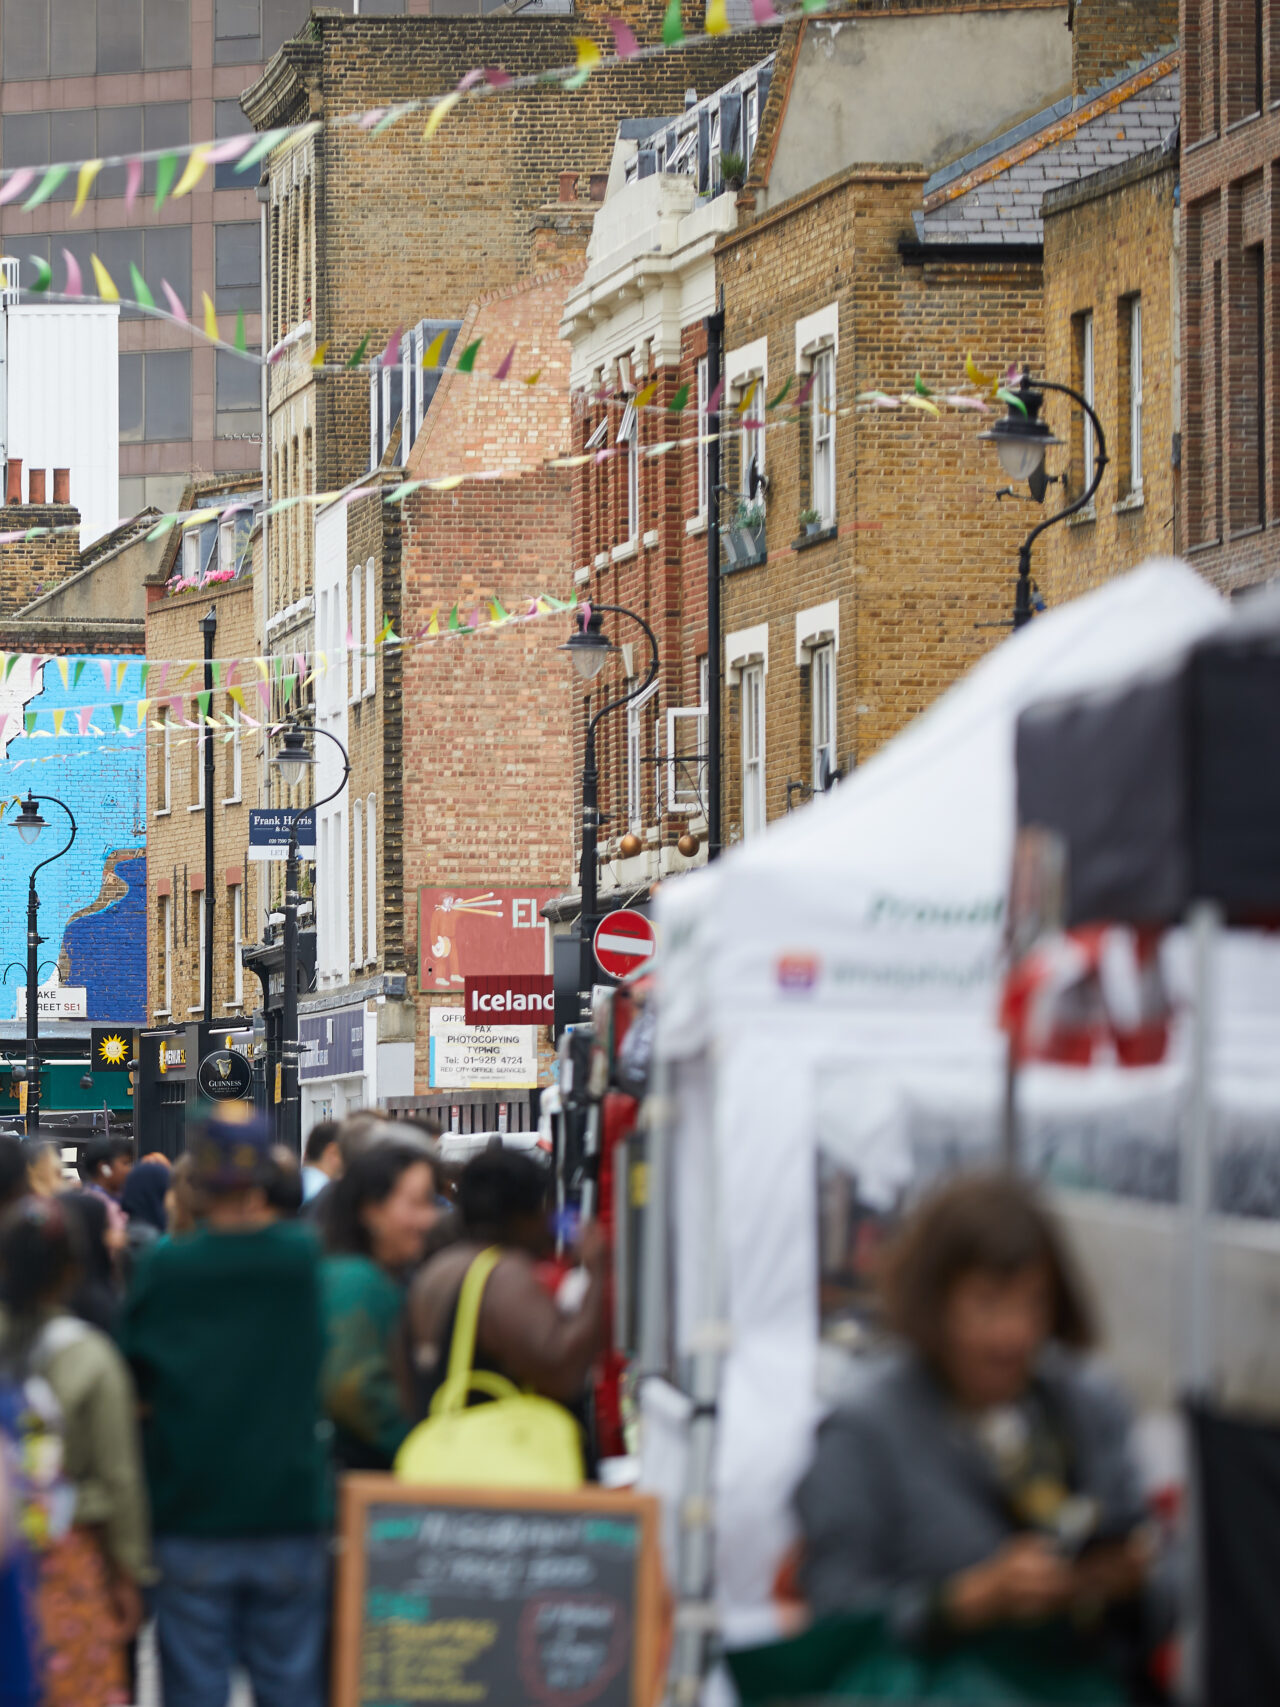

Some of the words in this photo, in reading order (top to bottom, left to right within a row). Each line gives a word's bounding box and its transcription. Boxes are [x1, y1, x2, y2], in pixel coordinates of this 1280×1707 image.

[254, 816, 280, 825] Frank
[472, 990, 554, 1011] Iceland
[64, 1003, 81, 1011] SE1
[447, 1036, 520, 1044] PHOTOCOPYING
[467, 1047, 500, 1055] TYPING
[463, 1057, 497, 1065] 01-928
[501, 1057, 523, 1065] 4724
